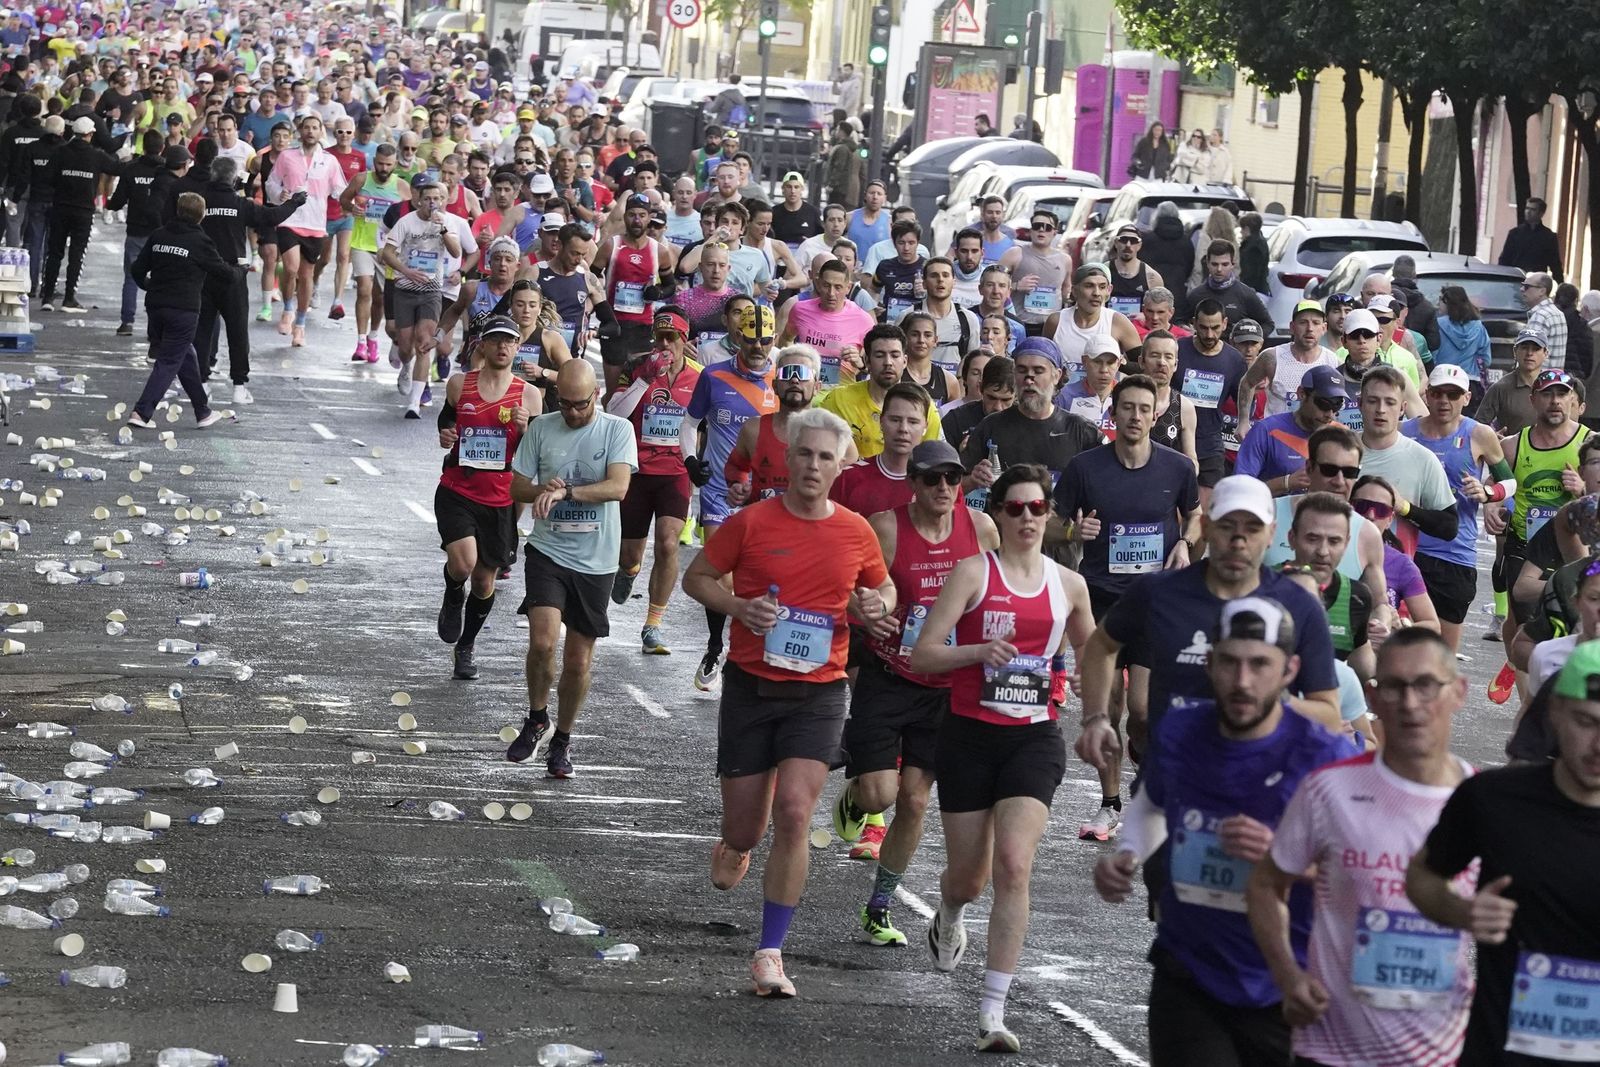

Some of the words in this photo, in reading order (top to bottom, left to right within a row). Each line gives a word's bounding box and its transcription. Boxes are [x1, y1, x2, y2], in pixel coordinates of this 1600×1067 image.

[674, 4, 694, 17] 30
[62, 169, 94, 179] VOLUNTEER
[805, 335, 827, 348] RUN
[1198, 372, 1221, 381] ZURICH
[659, 406, 684, 415] ZURICH
[475, 428, 503, 437] ZURICH
[648, 426, 680, 437] KANIJO
[475, 441, 491, 449] 8913
[464, 449, 502, 460] KRISTOF
[553, 510, 598, 521] ALBERTO
[1128, 525, 1159, 535] ZURICH
[1129, 540, 1147, 549] 8714
[1115, 550, 1159, 563] QUENTIN
[920, 560, 954, 571] GENERALI
[793, 611, 829, 628] ZURICH
[983, 610, 1017, 624] HYDE
[983, 622, 1016, 635] PARK
[790, 629, 812, 642] 5787
[784, 641, 811, 659] EDD
[994, 686, 1039, 704] HONOR
[1200, 863, 1236, 888] FLO
[1375, 962, 1437, 987] STEPH
